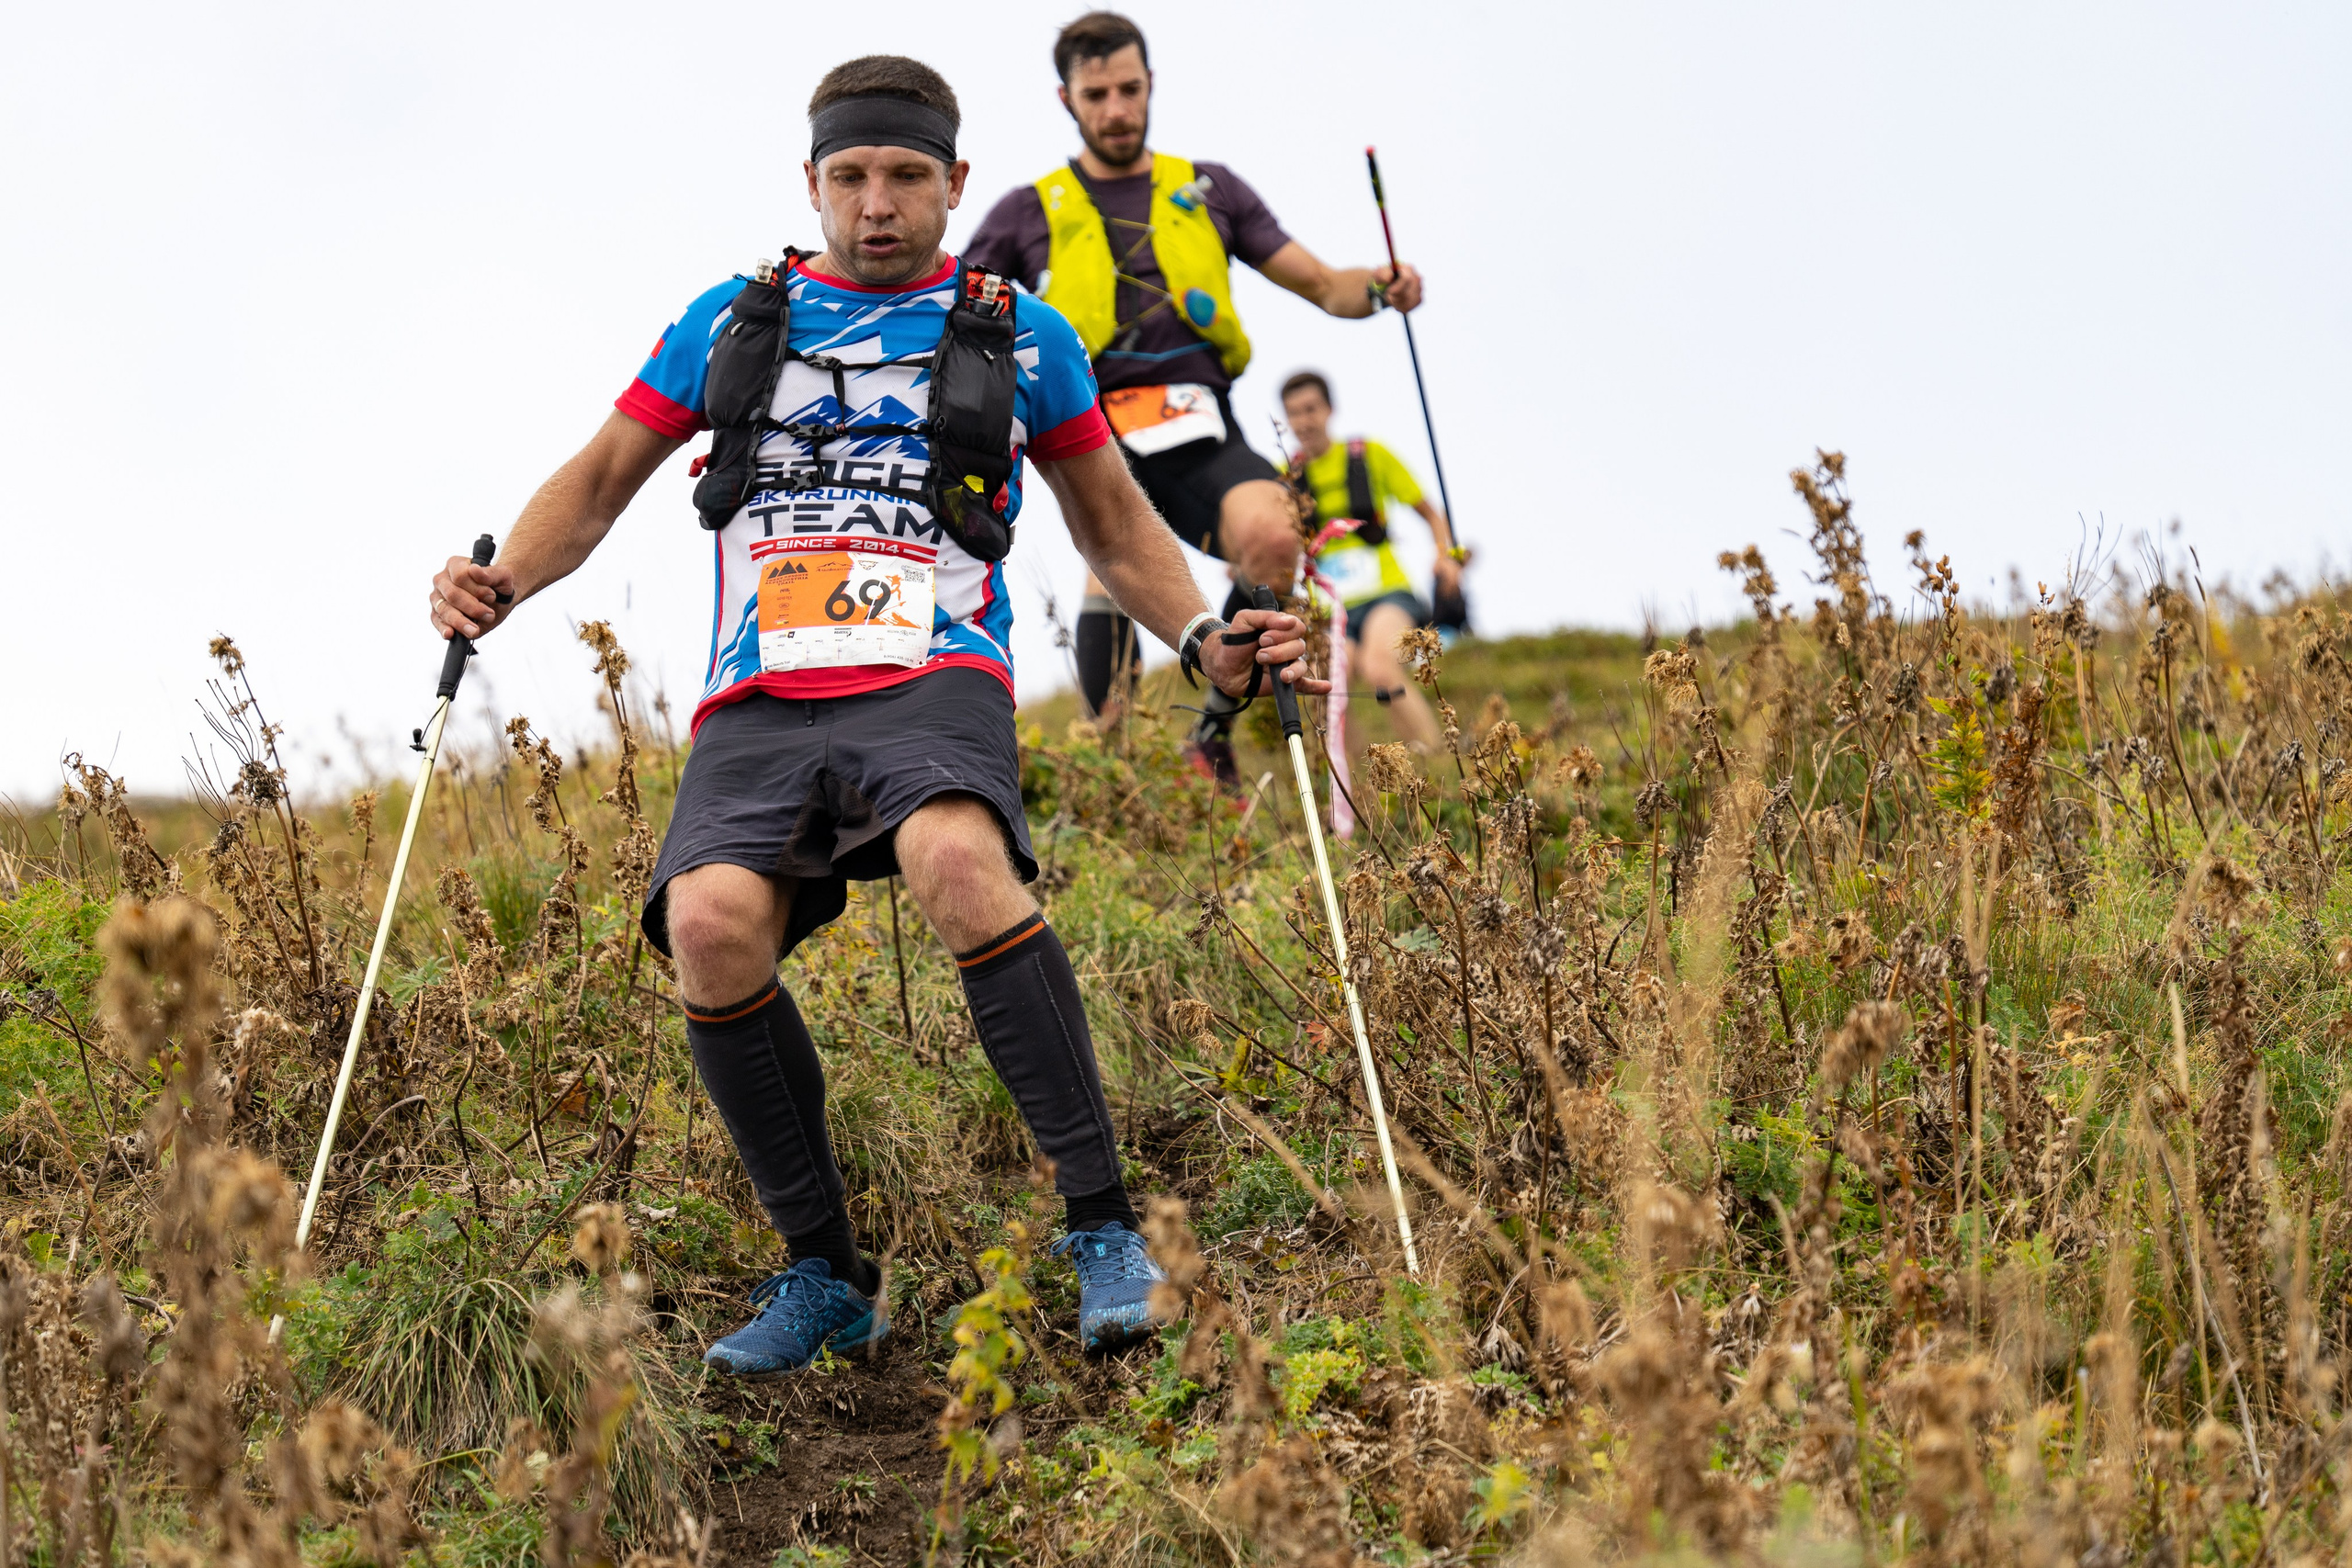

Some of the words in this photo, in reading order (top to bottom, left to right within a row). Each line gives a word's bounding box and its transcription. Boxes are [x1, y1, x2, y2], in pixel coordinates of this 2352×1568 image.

[1160, 391, 1196, 419] 62
[748, 503, 944, 546] TEAM
[775, 538, 837, 550] SINCE
[849, 539, 899, 553] 2014
[824, 579, 891, 622] 69
